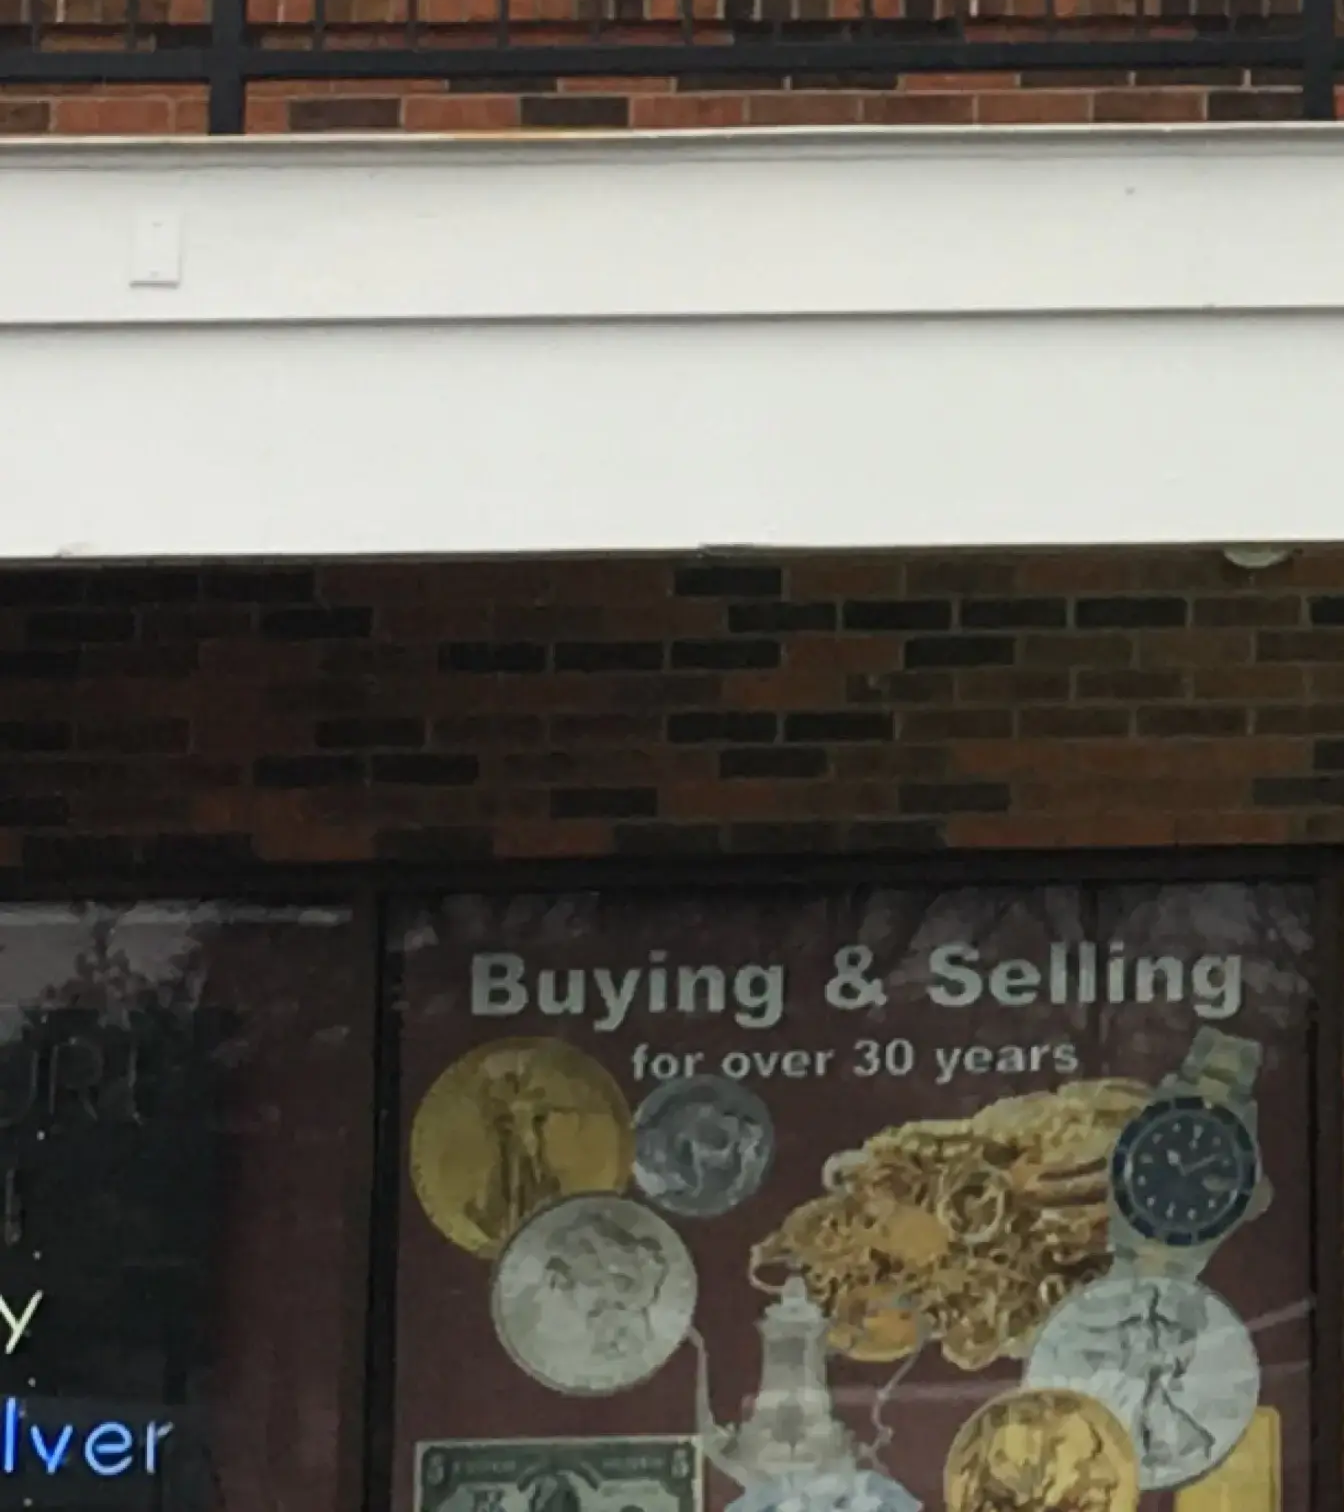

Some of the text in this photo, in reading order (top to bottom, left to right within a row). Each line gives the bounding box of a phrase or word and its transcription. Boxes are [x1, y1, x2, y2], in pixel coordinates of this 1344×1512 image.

[470, 941, 1243, 1031] Buying & Selling
[631, 1038, 1079, 1085] for over 30 years
